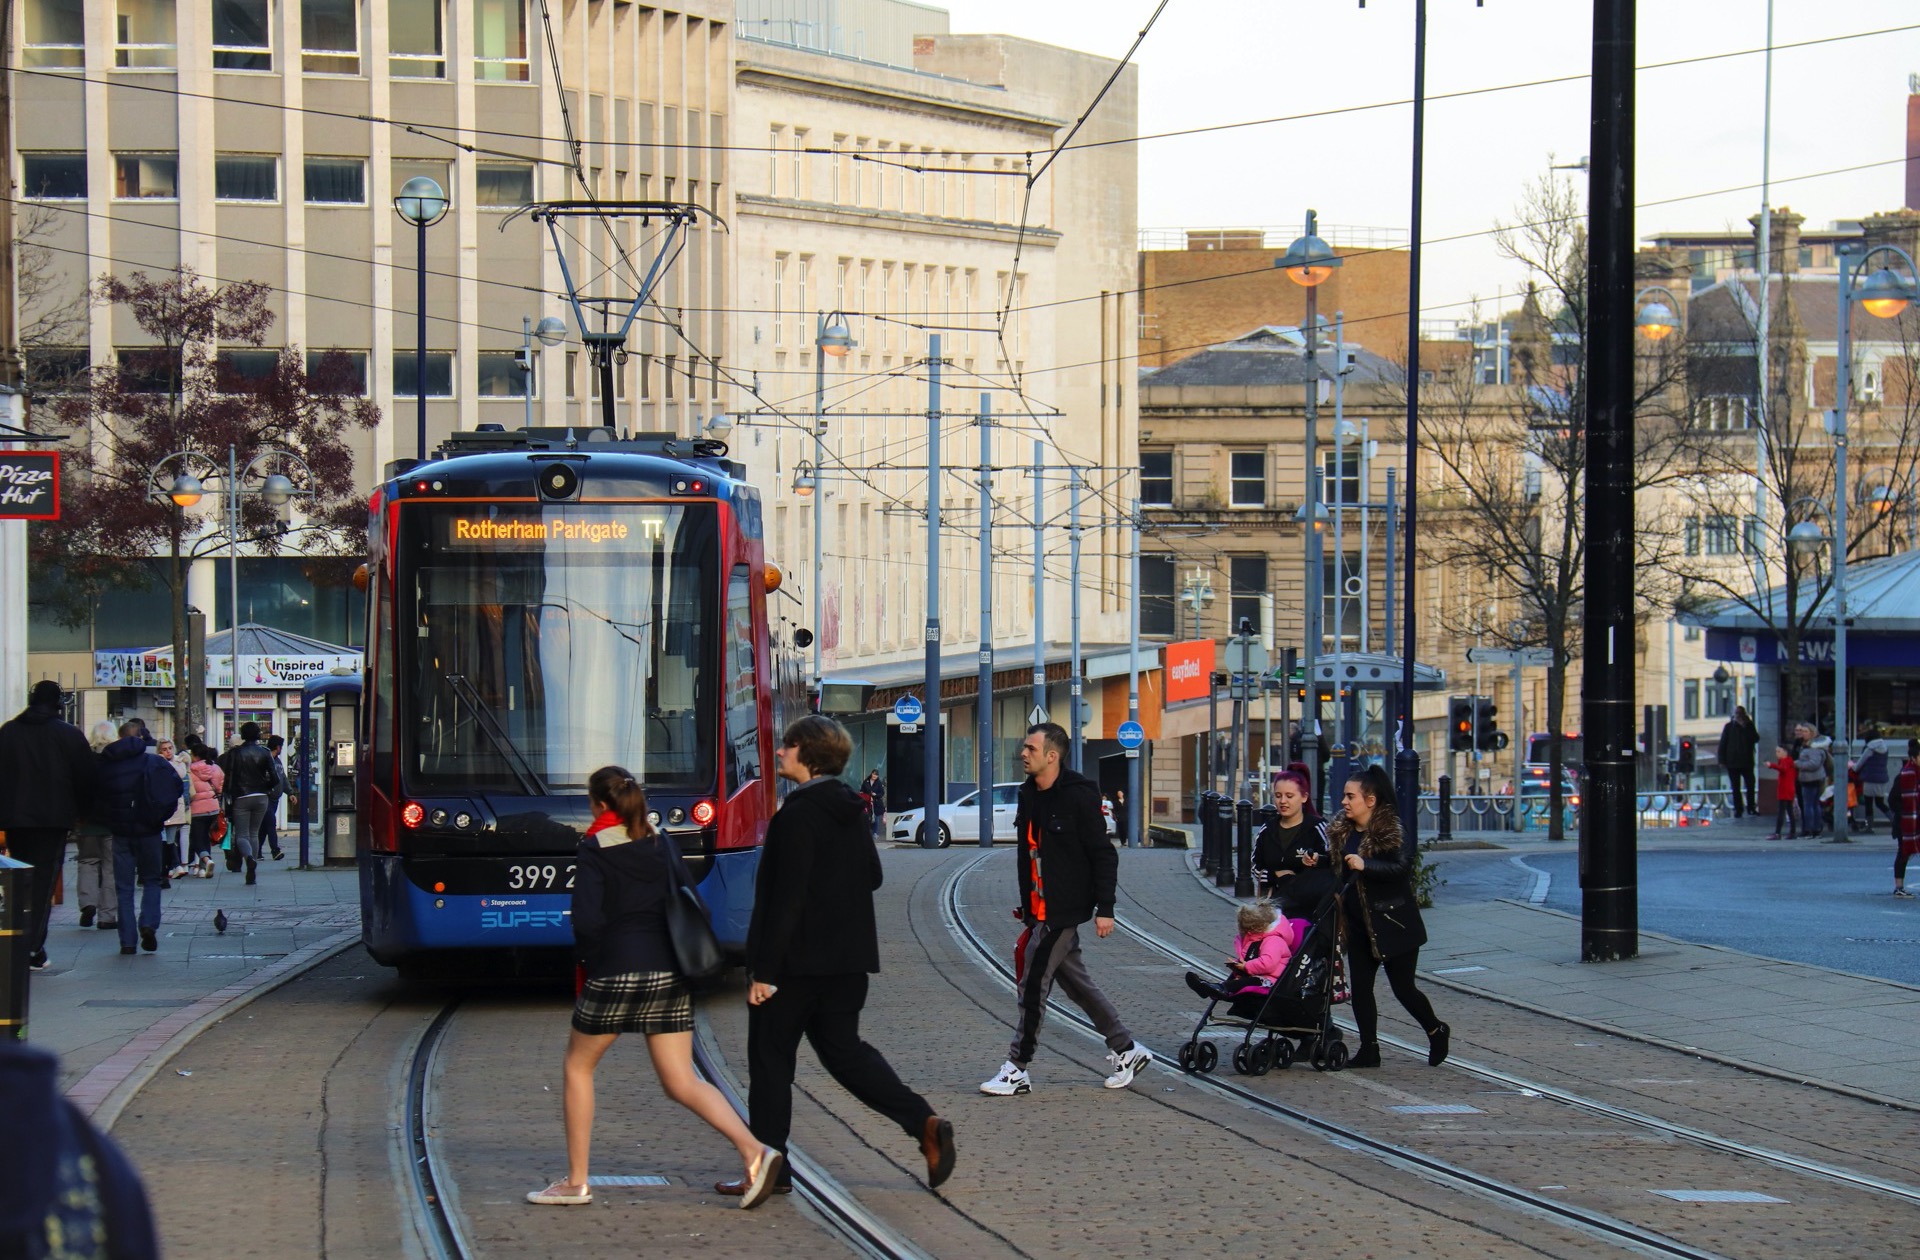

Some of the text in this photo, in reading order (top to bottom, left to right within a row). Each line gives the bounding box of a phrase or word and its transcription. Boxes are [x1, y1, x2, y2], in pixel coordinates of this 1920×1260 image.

[0, 465, 54, 485] Pizza
[0, 486, 46, 504] Hut
[456, 519, 663, 543] Rotherham Parkgate TT
[272, 660, 324, 671] Inspired
[279, 671, 322, 681] Vapo
[509, 865, 557, 889] 399
[491, 899, 527, 908] Stagecoach
